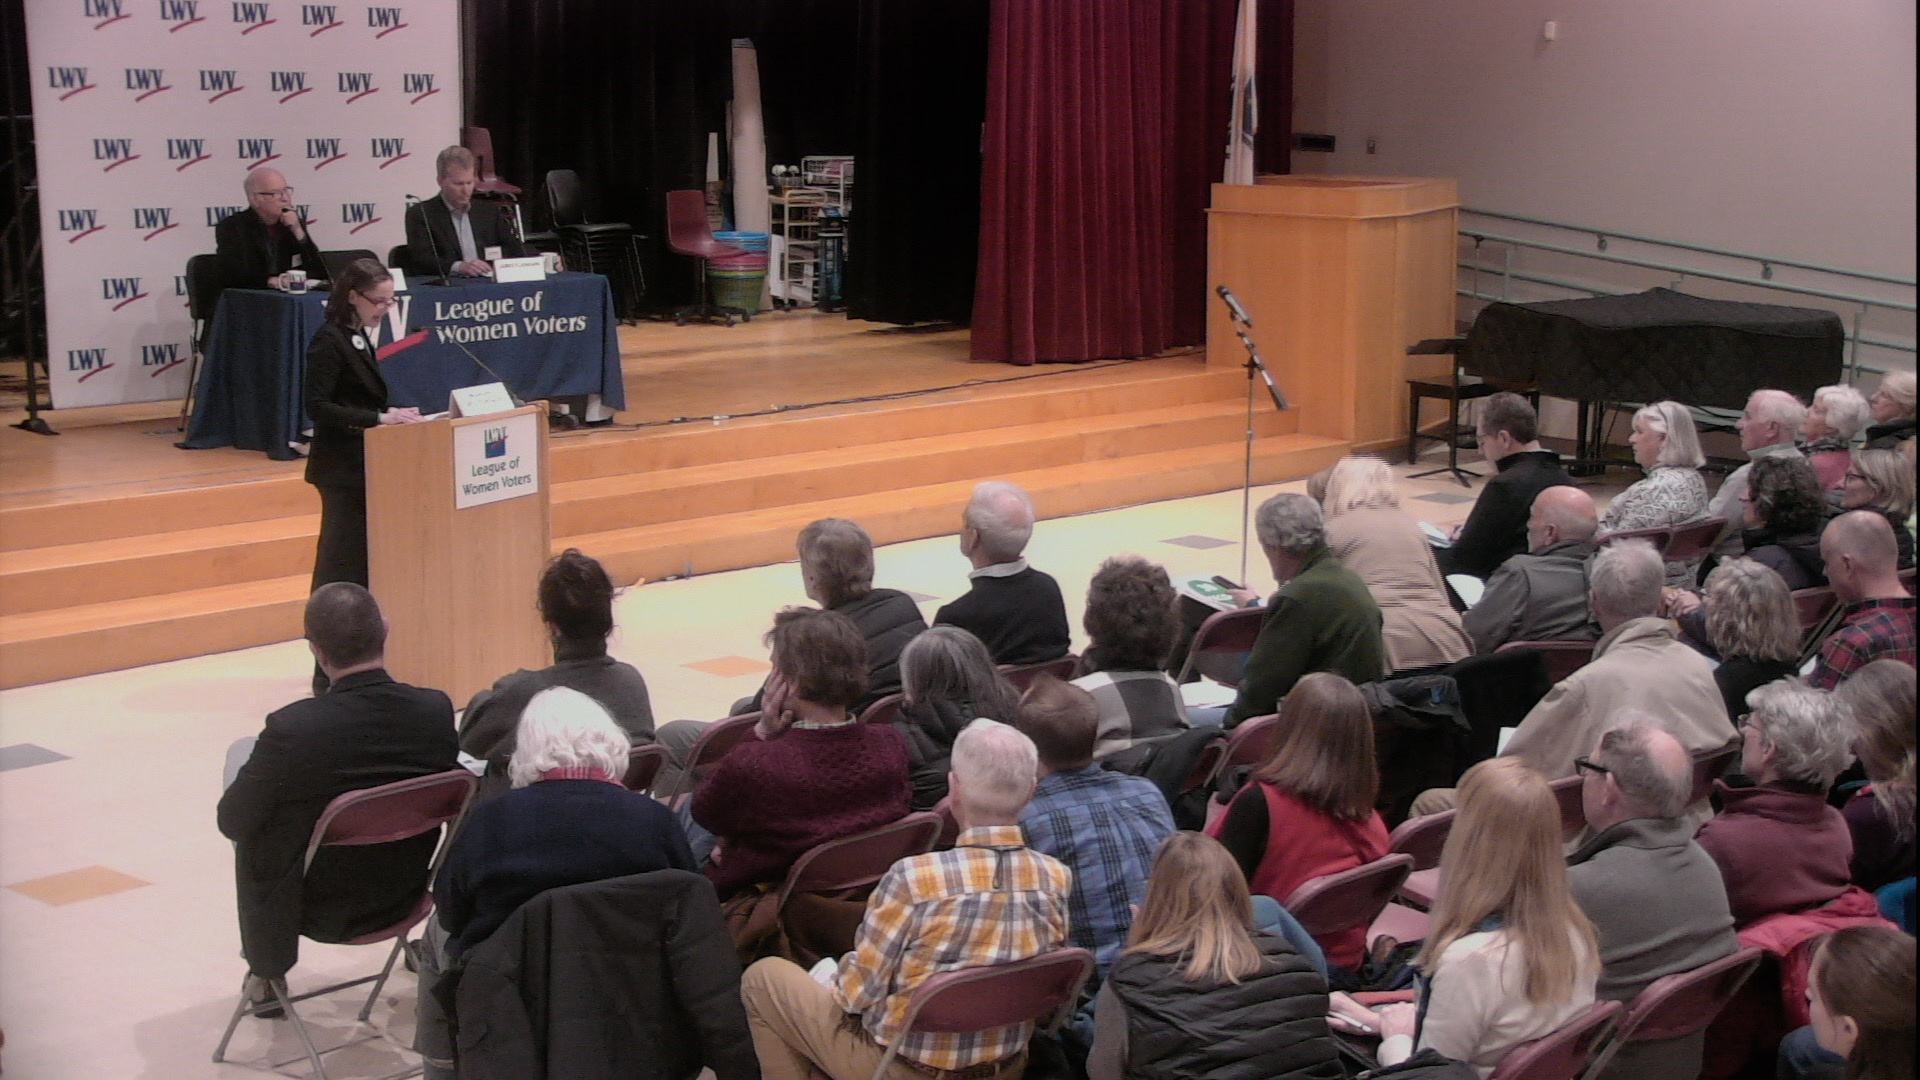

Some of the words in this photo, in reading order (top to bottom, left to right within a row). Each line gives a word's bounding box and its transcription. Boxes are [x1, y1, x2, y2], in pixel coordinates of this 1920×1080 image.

[85, 0, 120, 16] LWV
[160, 0, 197, 20] LWV
[233, 2, 268, 23] LWV
[303, 5, 336, 25] LWV
[368, 7, 400, 27] LWV
[48, 67, 86, 88] LWV
[126, 69, 162, 89] LWV
[200, 70, 236, 90] LWV
[271, 72, 304, 91] LWV
[339, 73, 371, 92] LWV
[404, 74, 433, 93] LWV
[94, 139, 131, 159] LWV
[167, 139, 203, 159] LWV
[238, 139, 273, 159] LWV
[307, 139, 339, 158] LWV
[372, 138, 403, 157] LWV
[59, 210, 96, 231] LWV
[134, 208, 170, 229] LWV
[342, 203, 374, 223] LWV
[103, 278, 139, 299] LWV
[434, 299, 514, 321] League
[521, 291, 543, 312] of
[436, 325, 518, 345] Women
[524, 315, 588, 335] Voters
[68, 348, 105, 370] LWV
[143, 344, 177, 365] LWV
[472, 461, 506, 477] League
[509, 456, 520, 469] of
[462, 481, 499, 496] Women
[501, 474, 531, 488] Voters
